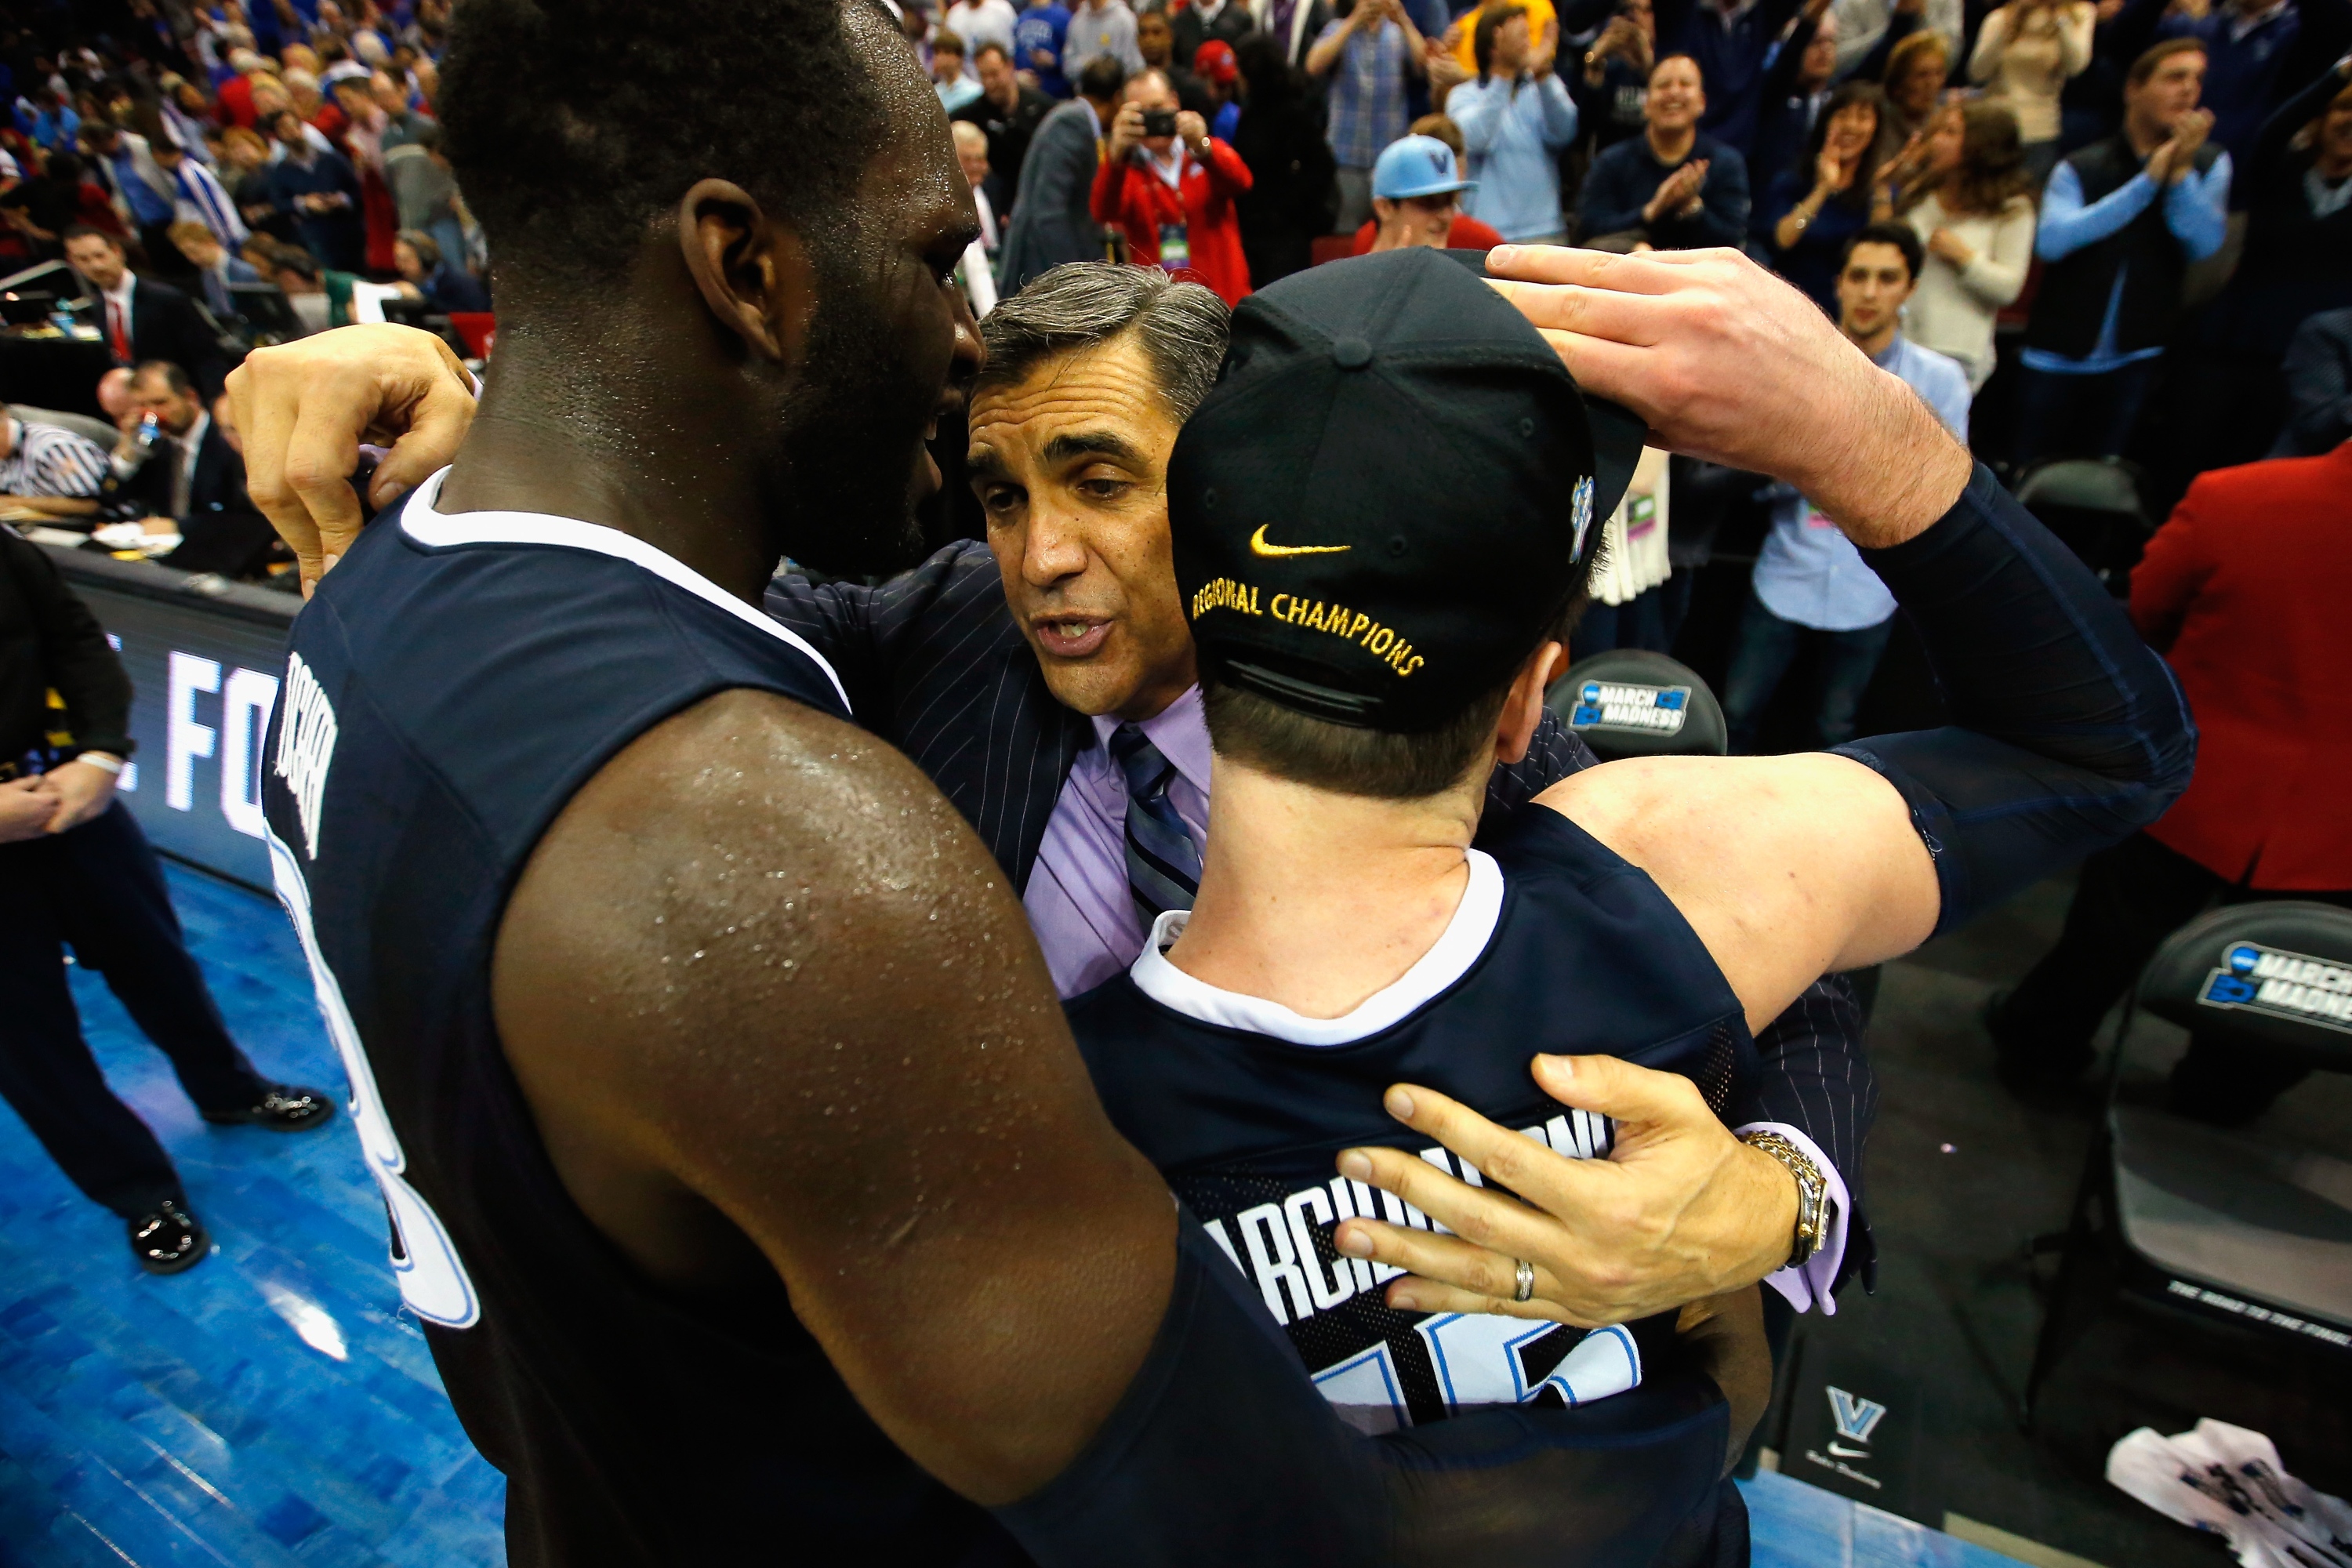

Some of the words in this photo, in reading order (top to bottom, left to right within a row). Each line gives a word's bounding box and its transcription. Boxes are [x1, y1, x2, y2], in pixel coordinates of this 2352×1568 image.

[1270, 593, 1425, 677] CHAMPIONS
[1599, 685, 1657, 707] MARCH
[1602, 704, 1683, 730] MADNESS
[1825, 1385, 1886, 1443] V
